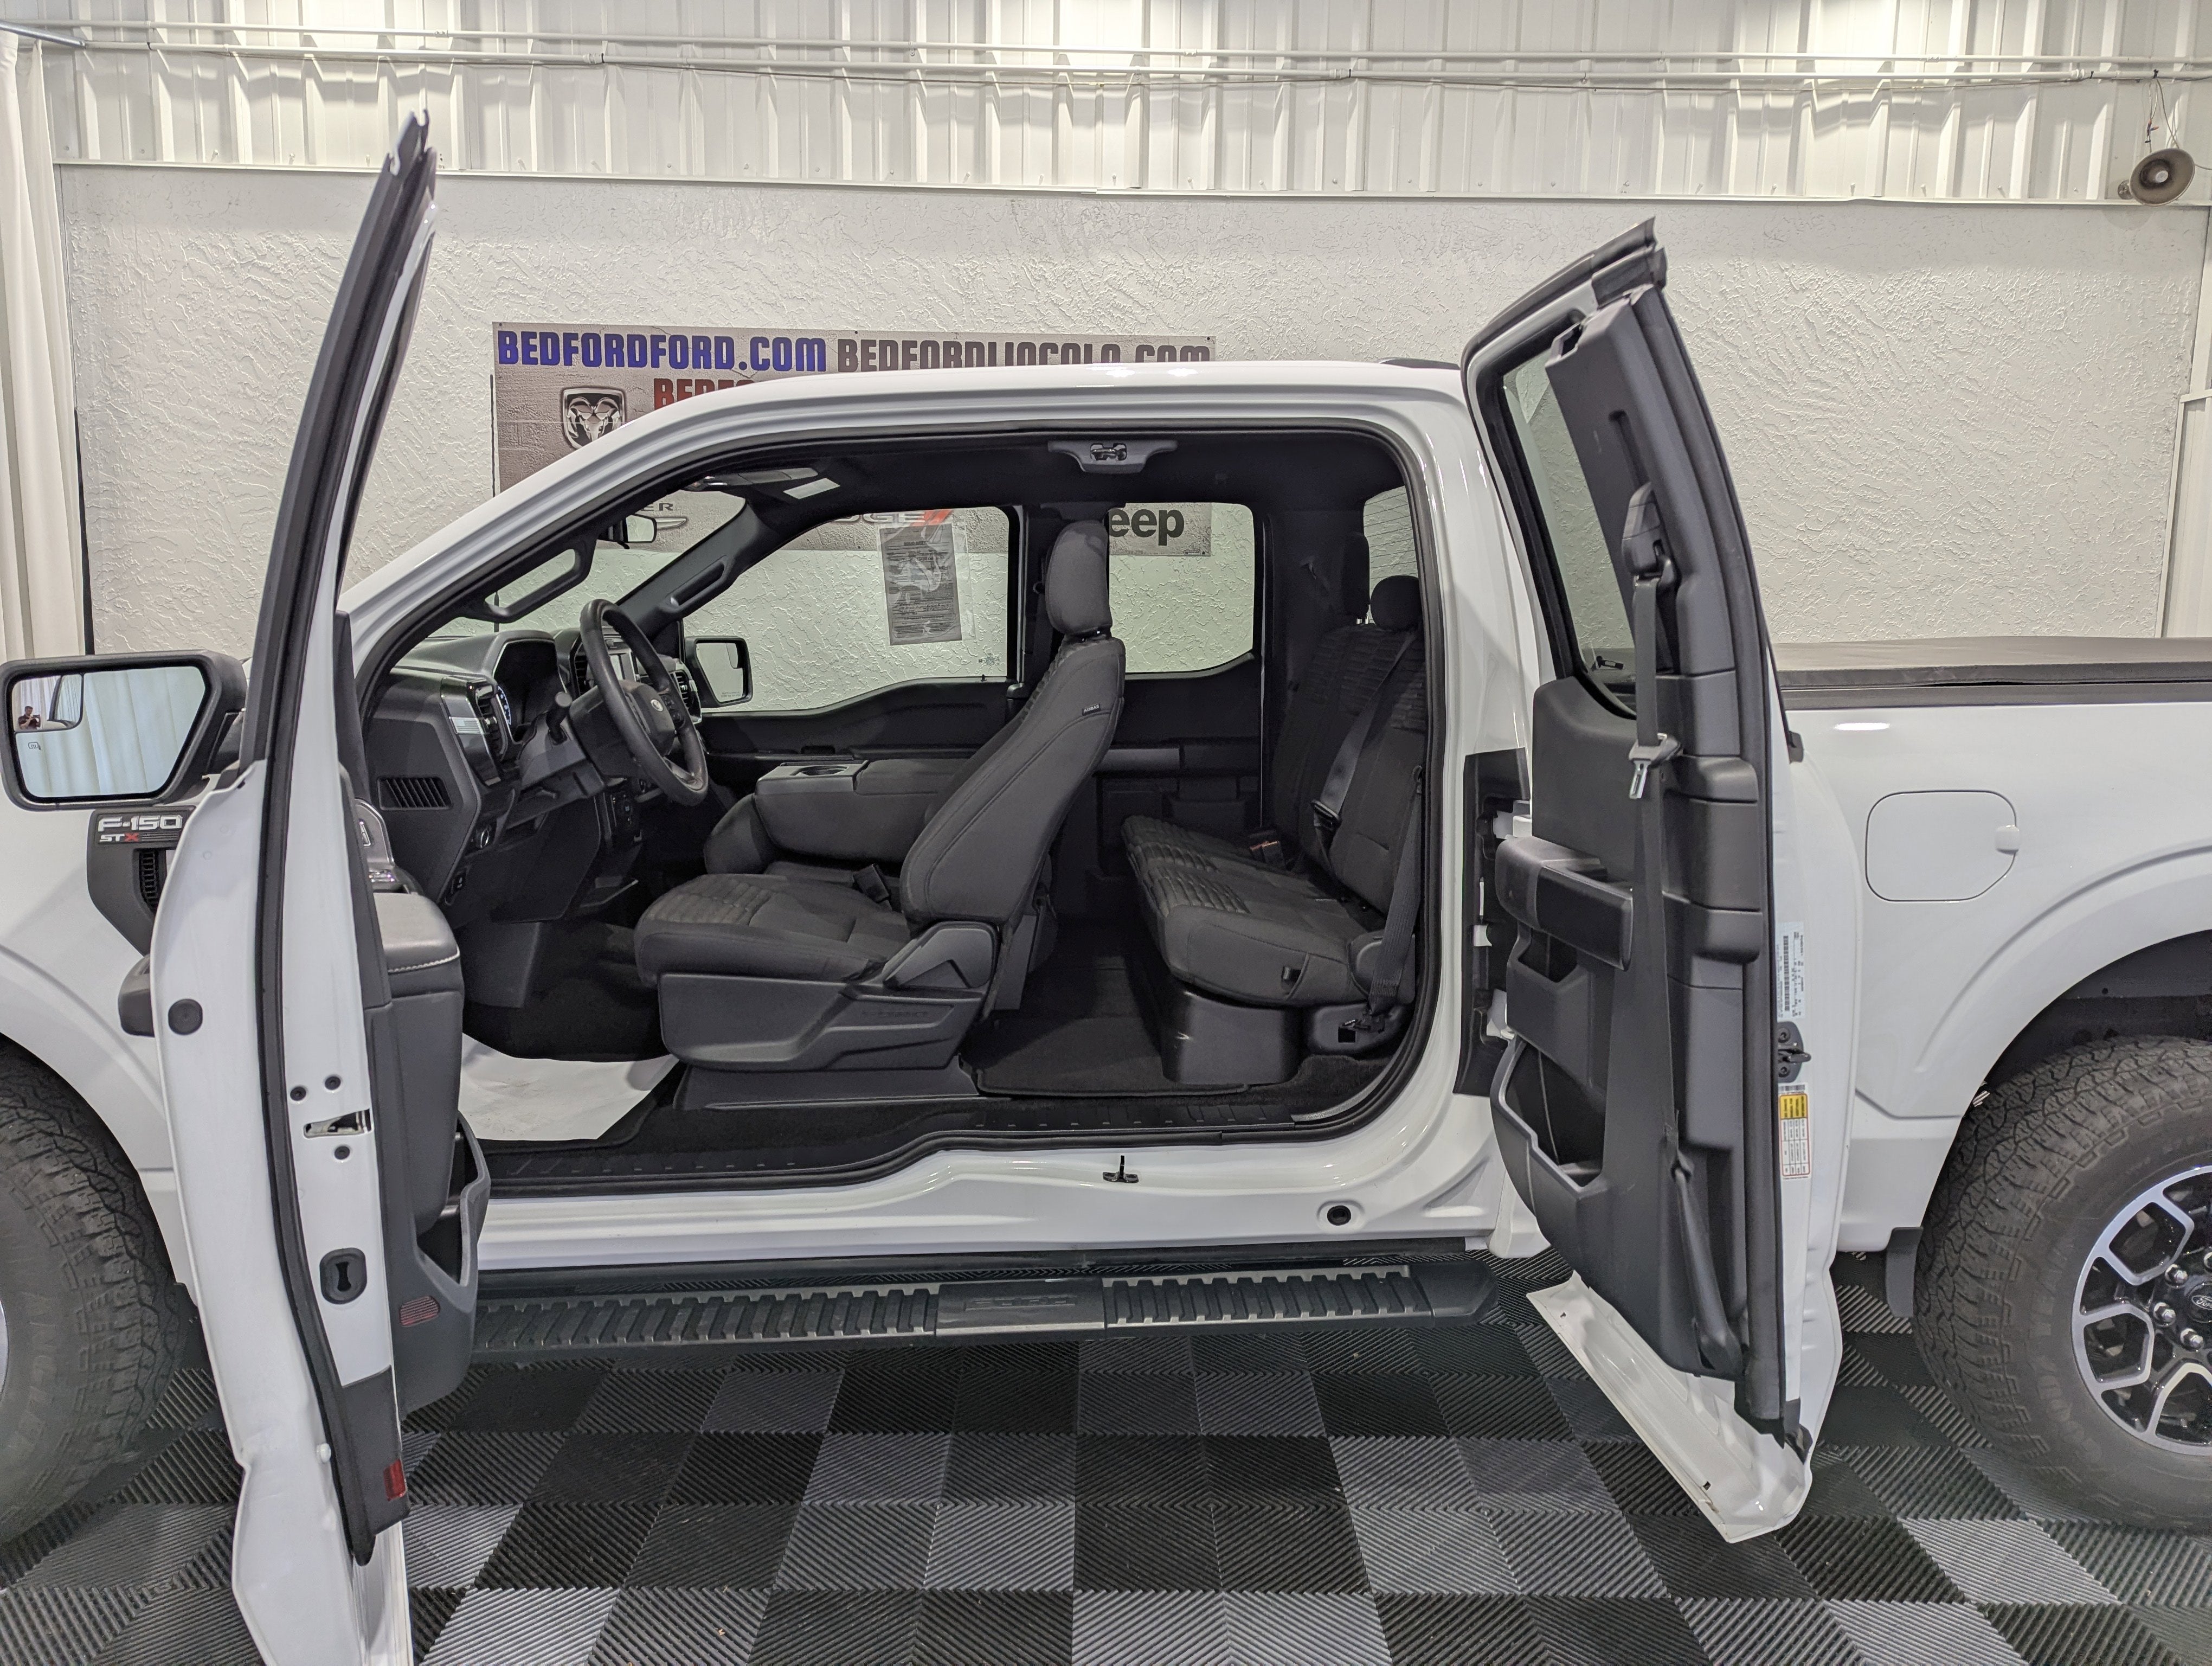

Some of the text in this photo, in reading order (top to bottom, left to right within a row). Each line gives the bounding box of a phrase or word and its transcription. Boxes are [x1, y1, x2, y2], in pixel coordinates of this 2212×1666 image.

[498, 330, 826, 371] BEDFORDFORD.COM
[1109, 509, 1185, 546] eep
[98, 815, 183, 832] F-150
[99, 832, 139, 842] STX
